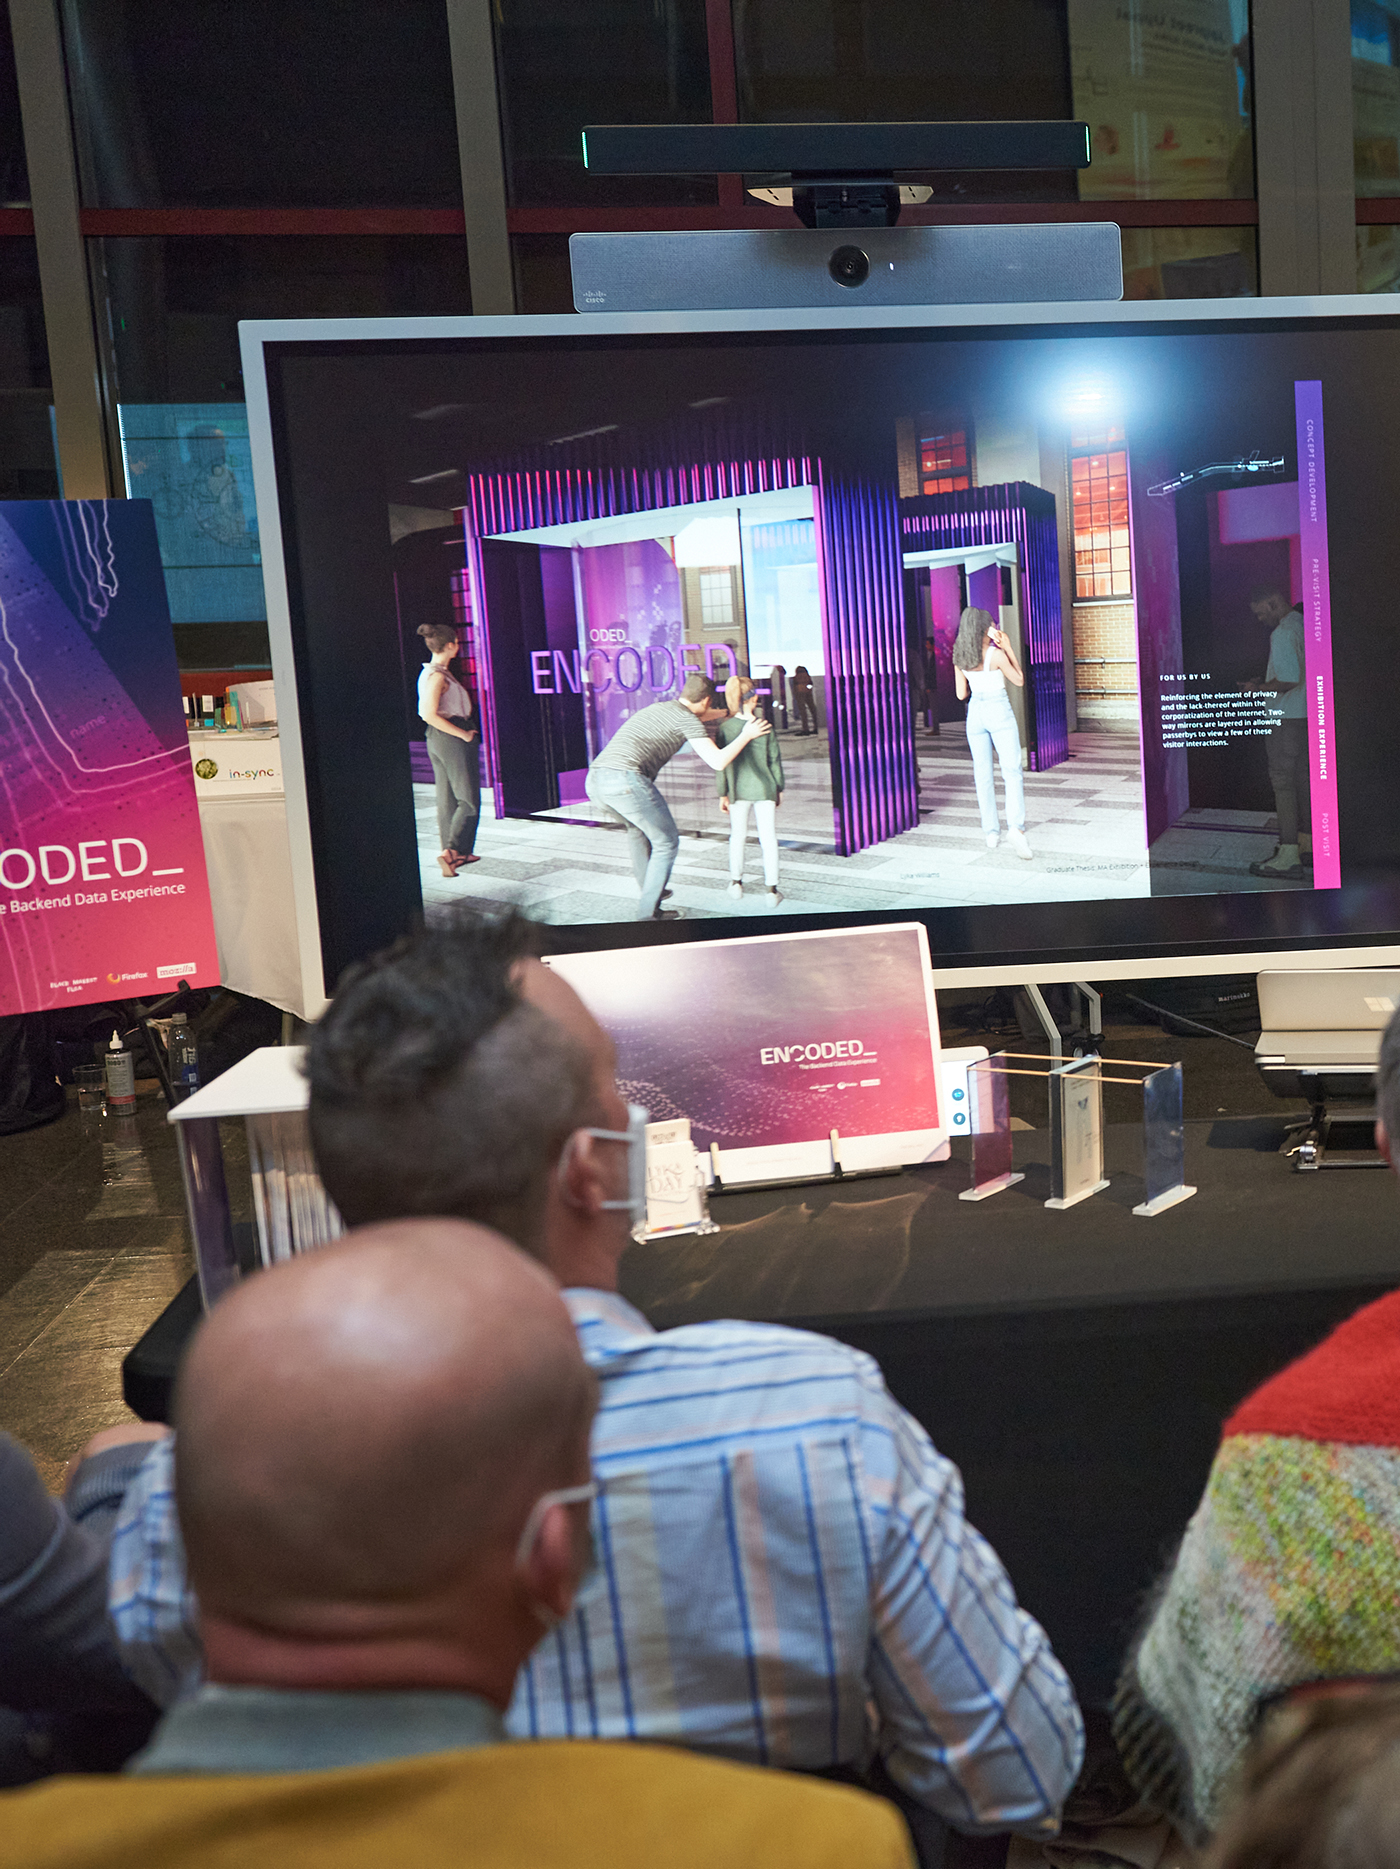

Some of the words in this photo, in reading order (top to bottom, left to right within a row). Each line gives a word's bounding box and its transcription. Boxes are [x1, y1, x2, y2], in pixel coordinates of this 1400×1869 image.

[1307, 420, 1315, 458] CONCEPT
[1308, 462, 1317, 522] DEVELOPMENT
[590, 629, 632, 643] ODED_
[1161, 693, 1200, 703] Reinforcing
[1252, 691, 1277, 700] privacy
[1317, 676, 1325, 726] EXHIBITION
[70, 716, 106, 738] name
[1162, 711, 1213, 721] corporatization
[1217, 719, 1244, 729] layered
[1251, 718, 1281, 728] allowing
[1163, 730, 1197, 740] passerbys
[1318, 729, 1327, 780] EXPERIENCE
[229, 769, 274, 780] in-sync
[0, 837, 184, 889] ODED_
[11, 894, 72, 914] Backend
[75, 892, 108, 906] Data
[111, 883, 185, 902] Experience
[122, 972, 148, 981] Firefox
[760, 1040, 877, 1065] ENCODED_
